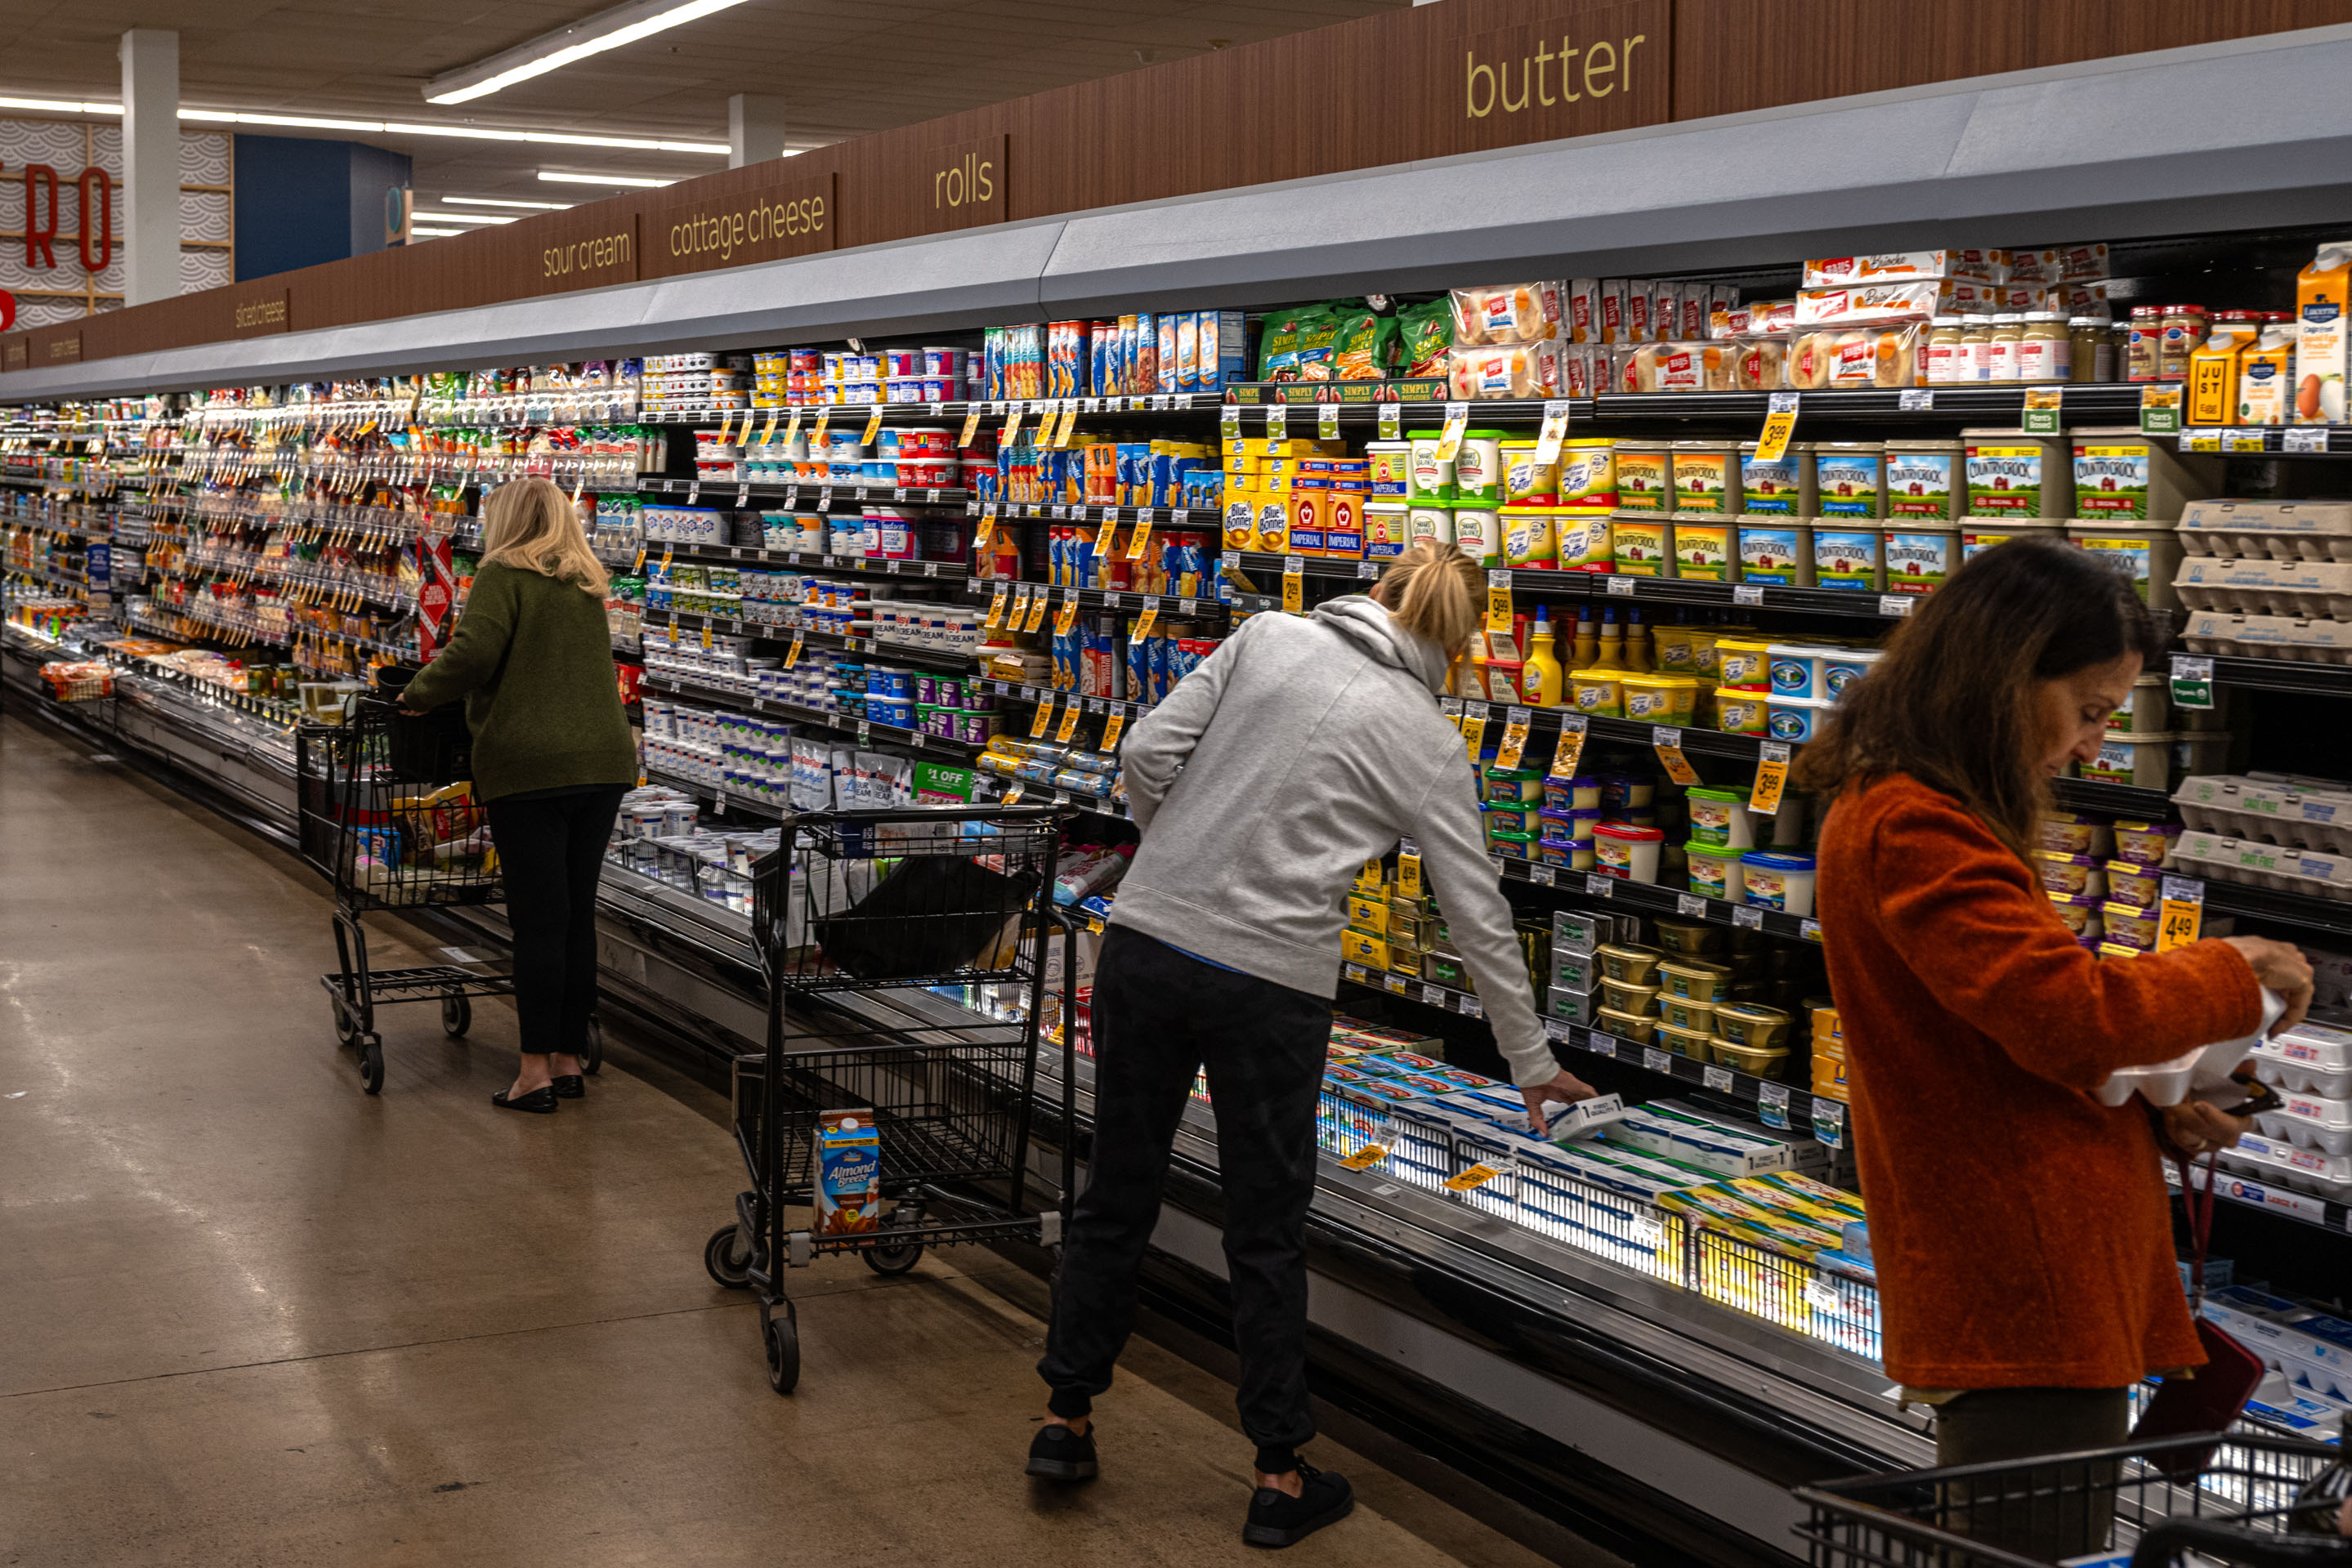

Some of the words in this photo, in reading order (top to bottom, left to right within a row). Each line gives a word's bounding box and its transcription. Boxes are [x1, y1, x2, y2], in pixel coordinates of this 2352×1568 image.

[1467, 35, 1645, 118] butter
[935, 153, 994, 208] rolls
[0, 162, 110, 271] RO
[670, 211, 744, 260] cottage
[748, 195, 825, 243] cheese
[543, 243, 575, 277] sour
[579, 230, 630, 270] cream
[235, 302, 257, 328] sliced
[257, 300, 284, 323] cheese
[1344, 386, 1371, 395] SIMPLY
[1402, 384, 1429, 394] SIMPLY
[1970, 462, 2002, 478] COUNTRY
[2003, 462, 2032, 480] CROCK
[2077, 462, 2108, 479] COUNTRY
[2108, 462, 2138, 480] CROCK
[1231, 503, 1247, 517] Blue
[1264, 504, 1281, 518] Blue
[1225, 516, 1252, 530] Bonnet
[1260, 518, 1286, 532] Bonnet
[1291, 534, 1321, 546] IMPERIAL
[1329, 537, 1358, 548] IMPERIAL
[940, 771, 964, 784] OFF
[2166, 915, 2193, 941] 449
[1582, 1104, 1590, 1118] 1
[1593, 1101, 1609, 1110] FIRST
[1615, 1098, 1622, 1112] 1
[1591, 1107, 1614, 1117] QUALITY
[1748, 1156, 1754, 1170] 1
[1779, 1151, 1784, 1164] 1
[828, 1160, 877, 1181] Almond
[838, 1173, 870, 1188] Breeze
